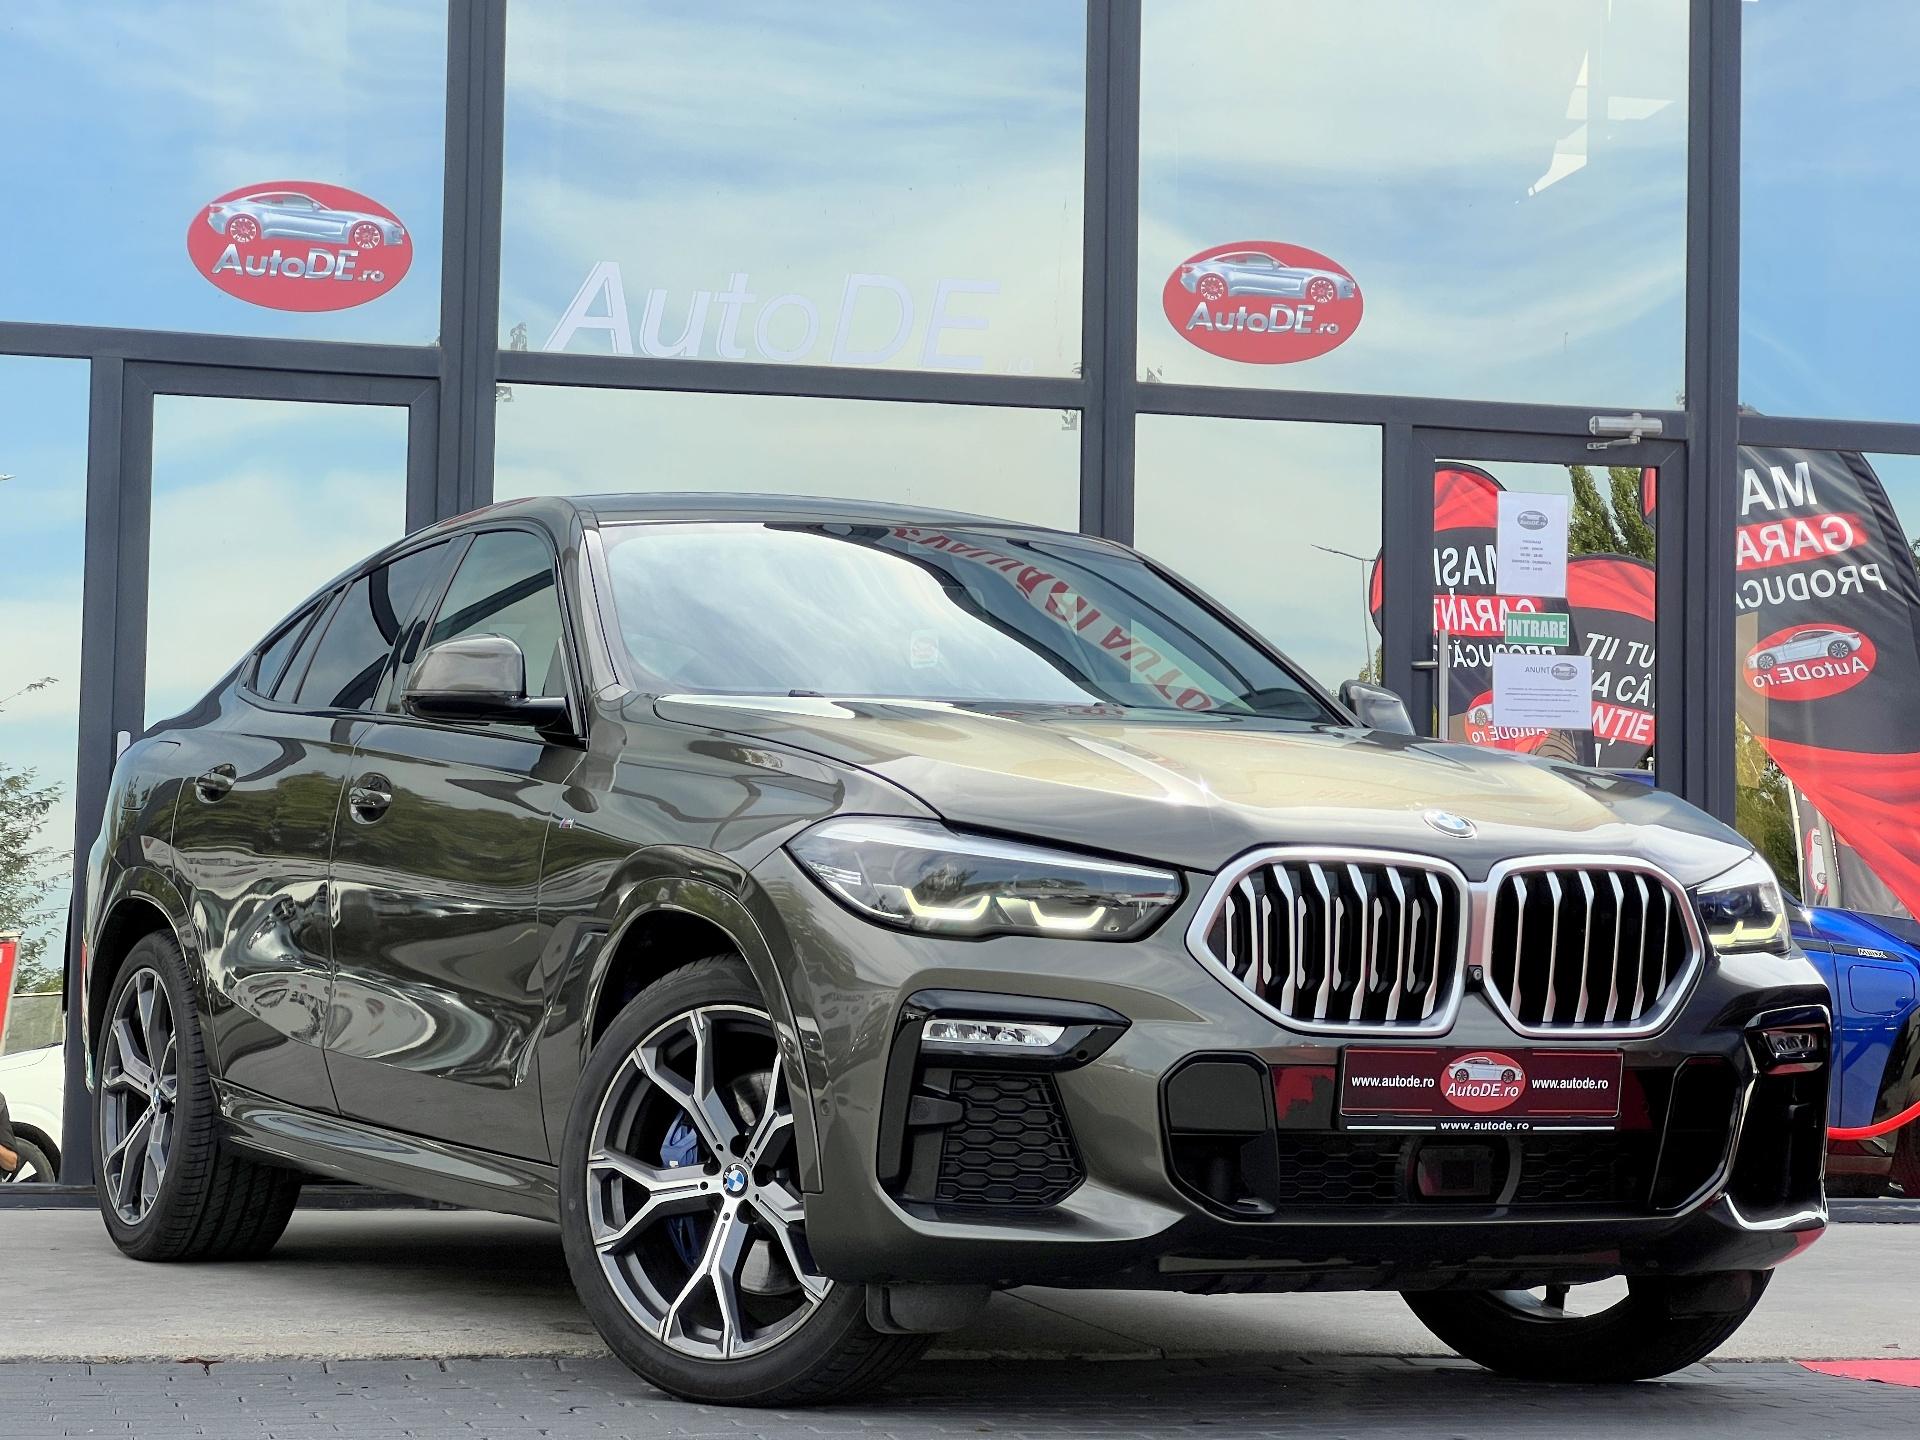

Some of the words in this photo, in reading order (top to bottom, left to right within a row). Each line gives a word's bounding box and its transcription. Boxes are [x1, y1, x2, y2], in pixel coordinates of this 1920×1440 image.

[1508, 619, 1567, 639] INTRARE
[1351, 1075, 1435, 1088] www.autode.ro
[1445, 1083, 1519, 1097] AutoDE.ro
[1532, 1078, 1609, 1090] www.autode.ro
[1440, 1121, 1530, 1131] www.autode.ro
